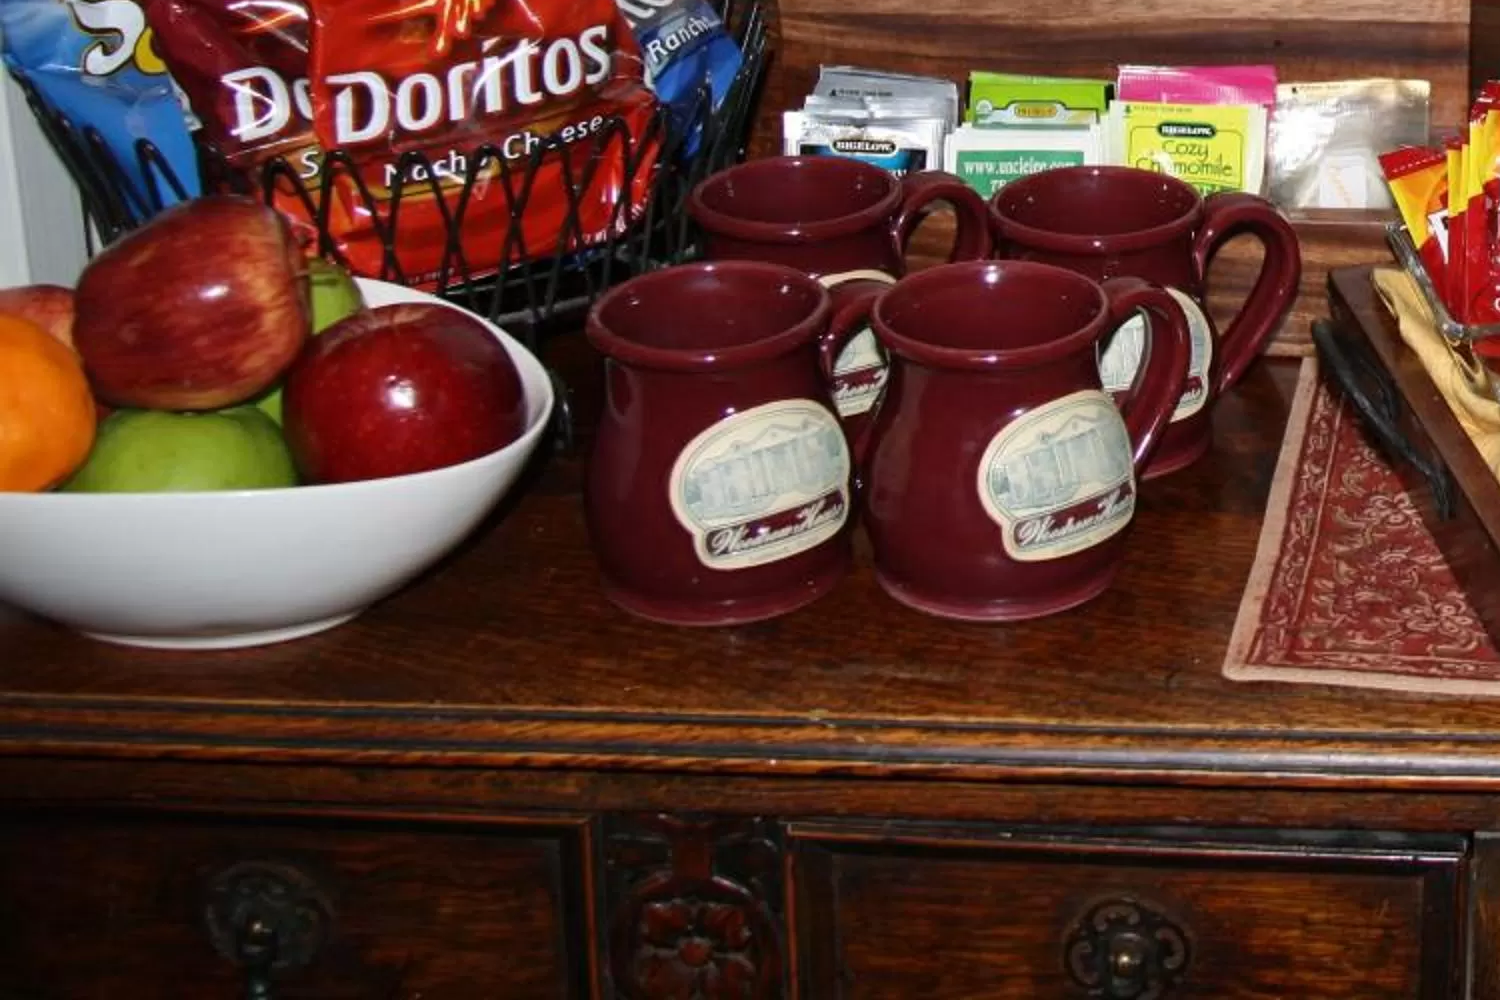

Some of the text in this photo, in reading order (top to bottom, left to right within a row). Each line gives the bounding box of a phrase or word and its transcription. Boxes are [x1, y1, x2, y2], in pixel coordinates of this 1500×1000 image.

[647, 15, 711, 62] Ranch
[326, 25, 611, 144] Doritos
[502, 114, 603, 161] Chese
[1161, 139, 1209, 162] Cozy
[1136, 151, 1233, 177] Chmomile
